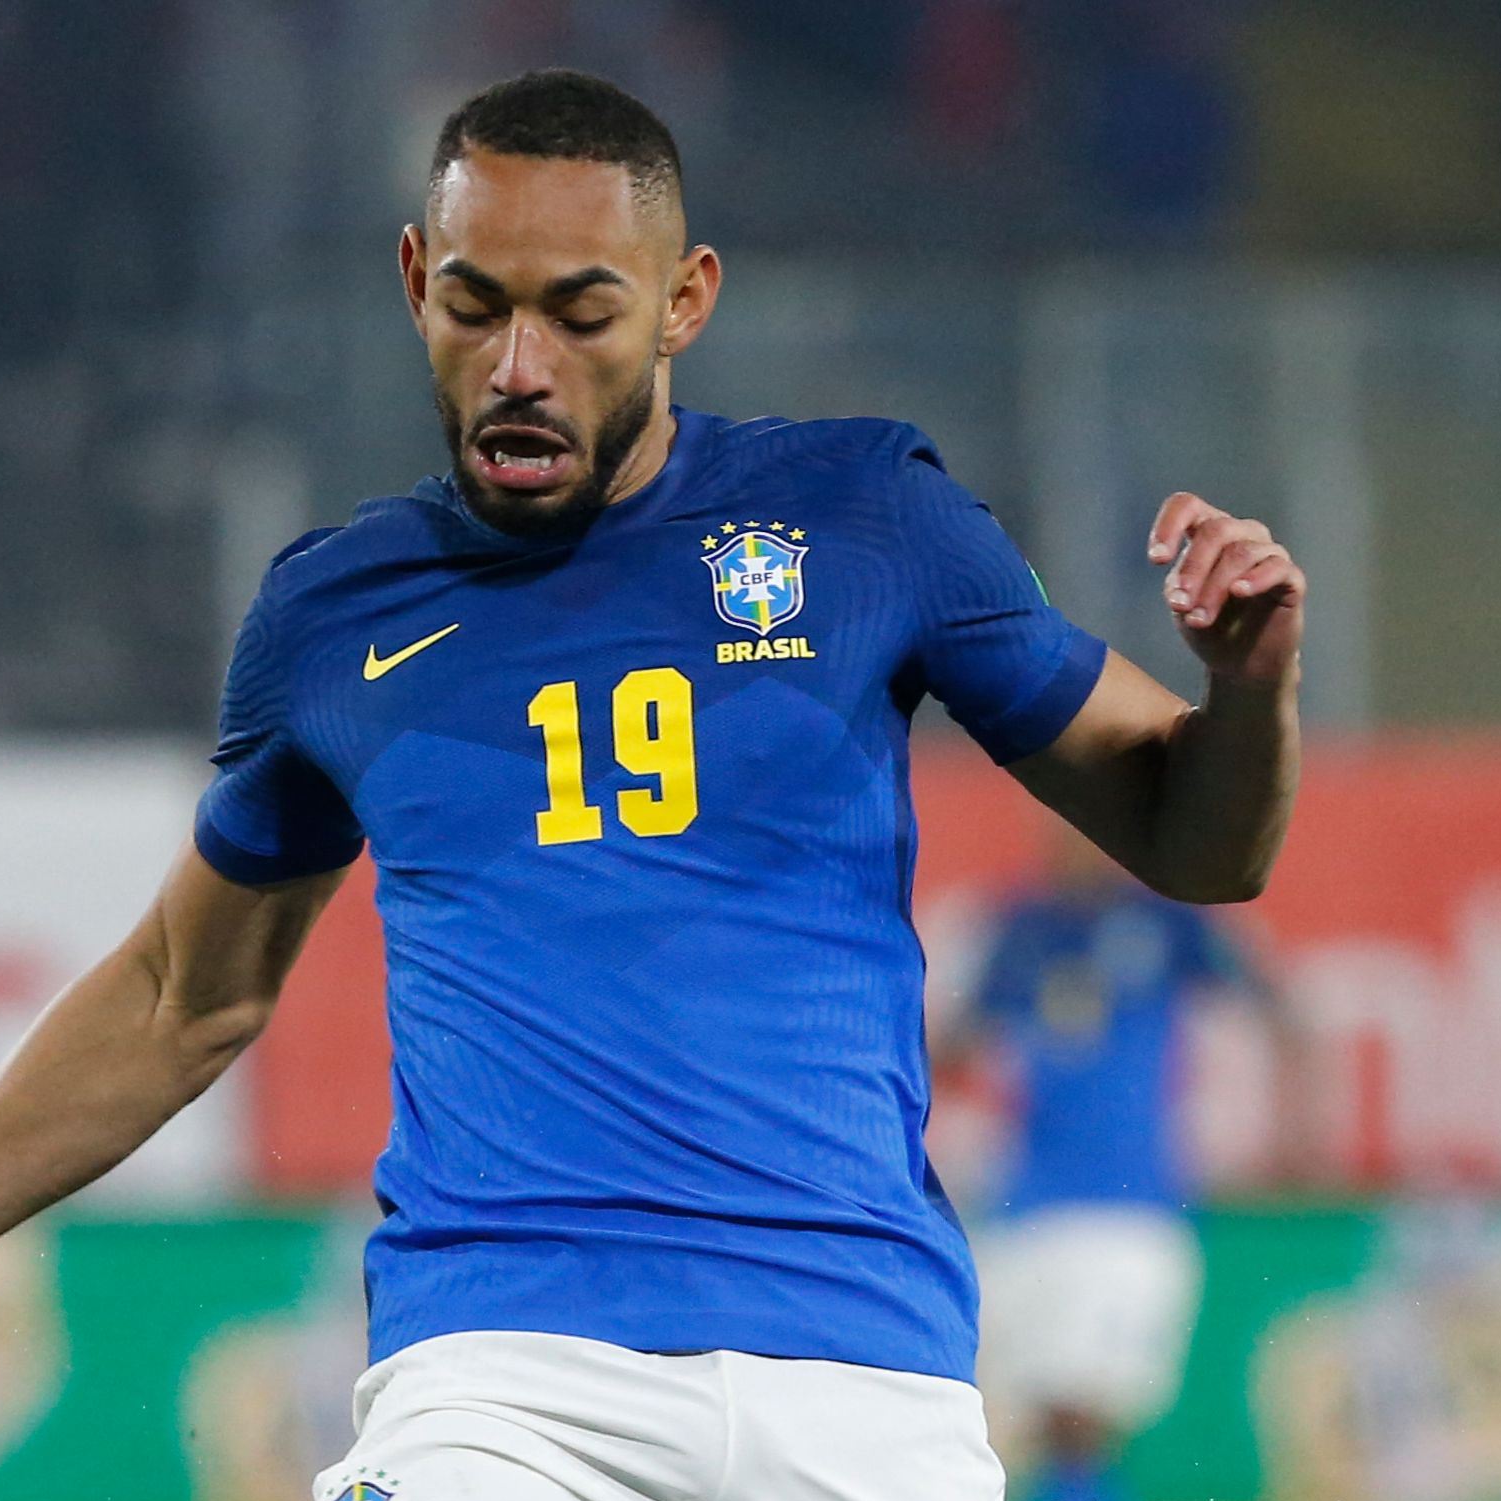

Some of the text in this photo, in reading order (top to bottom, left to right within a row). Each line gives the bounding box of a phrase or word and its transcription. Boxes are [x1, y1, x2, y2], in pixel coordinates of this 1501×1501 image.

[740, 572, 773, 586] CBF
[716, 637, 817, 664] BRASIL
[527, 666, 699, 846] 19
